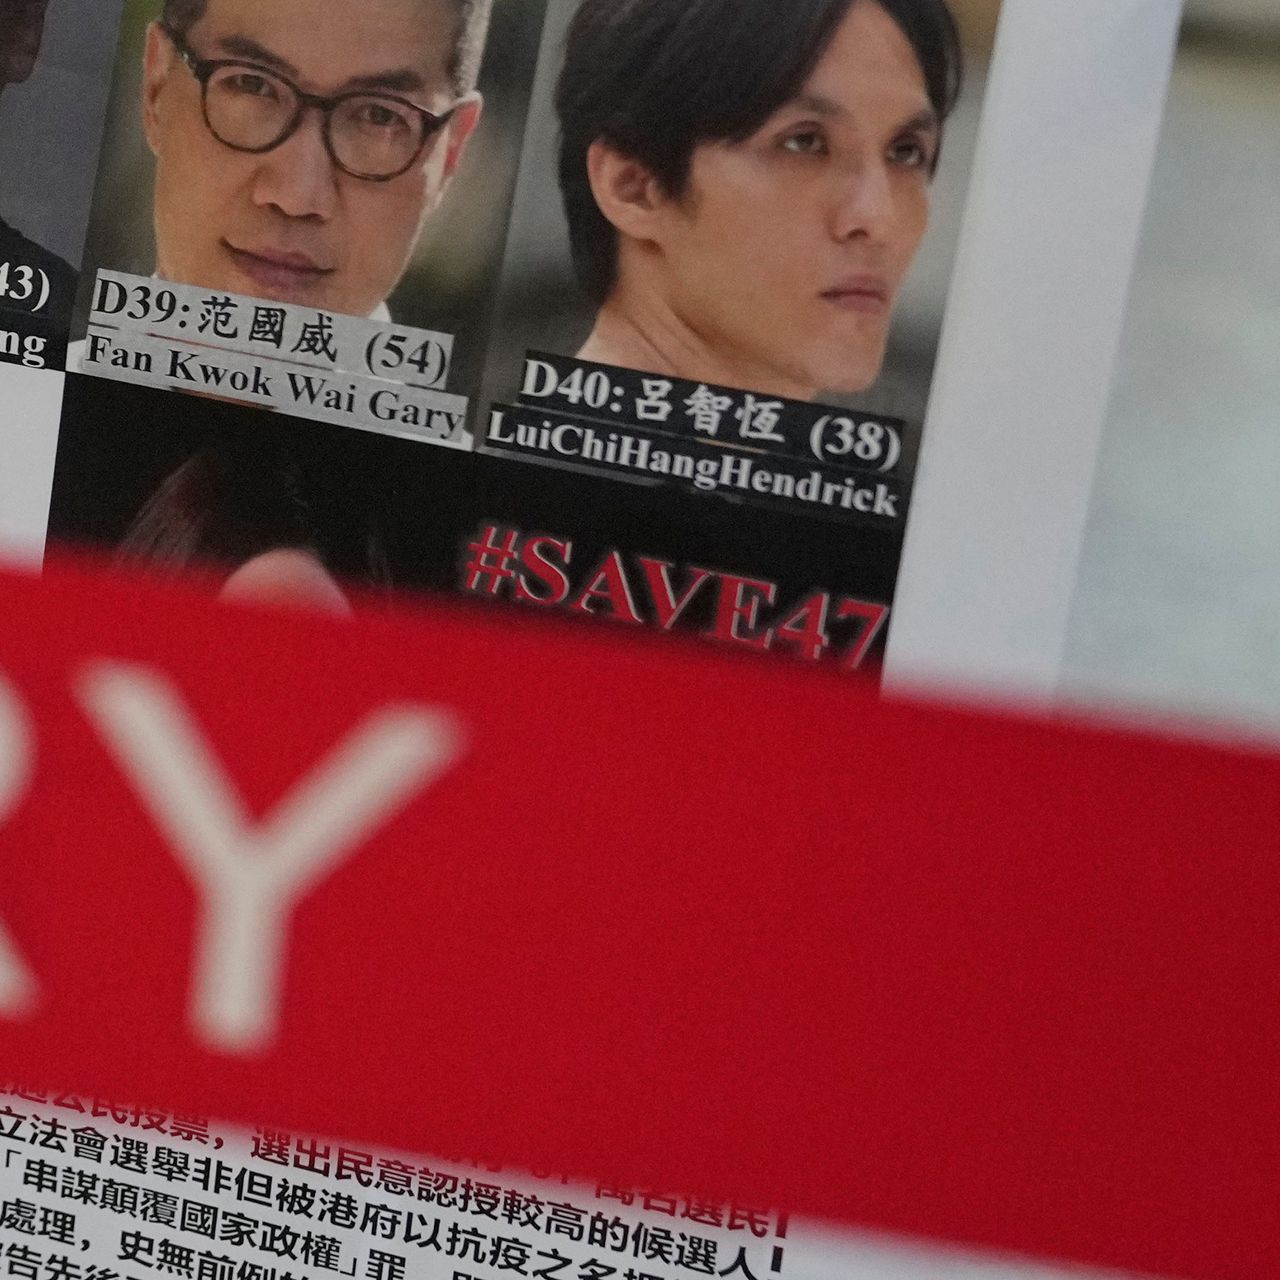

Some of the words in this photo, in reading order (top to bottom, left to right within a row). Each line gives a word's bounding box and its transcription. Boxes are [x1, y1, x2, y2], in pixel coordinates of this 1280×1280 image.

[93, 279, 339, 363] D39:范國威
[363, 330, 448, 386] (54)
[86, 337, 152, 375] Fan
[165, 349, 273, 398] Kwok
[286, 374, 356, 414] Wai
[368, 392, 464, 442] Gary
[809, 414, 902, 472] (38)
[490, 411, 899, 518] LuiChiHangHendrick
[465, 525, 891, 669] #SAVE47
